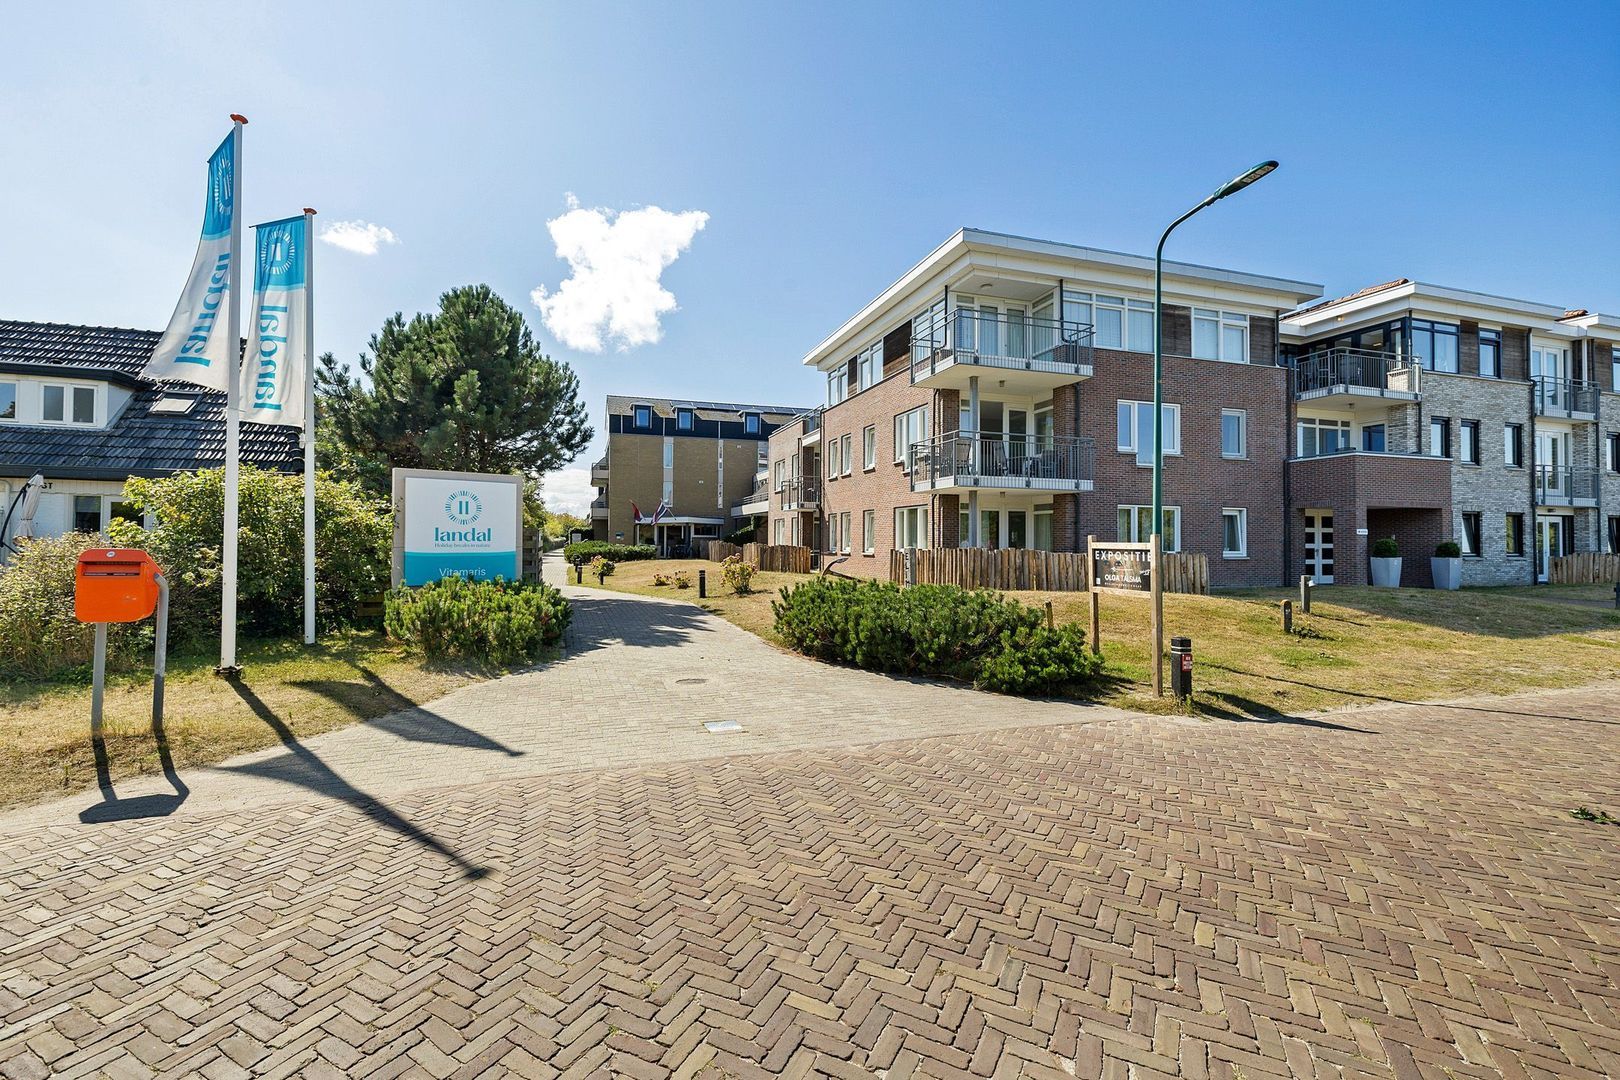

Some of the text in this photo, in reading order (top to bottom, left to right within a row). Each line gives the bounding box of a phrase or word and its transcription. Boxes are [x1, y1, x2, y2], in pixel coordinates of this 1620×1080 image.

[434, 527, 491, 542] landal
[1095, 550, 1153, 562] EXPOSITIE
[439, 567, 487, 577] Vitamaris
